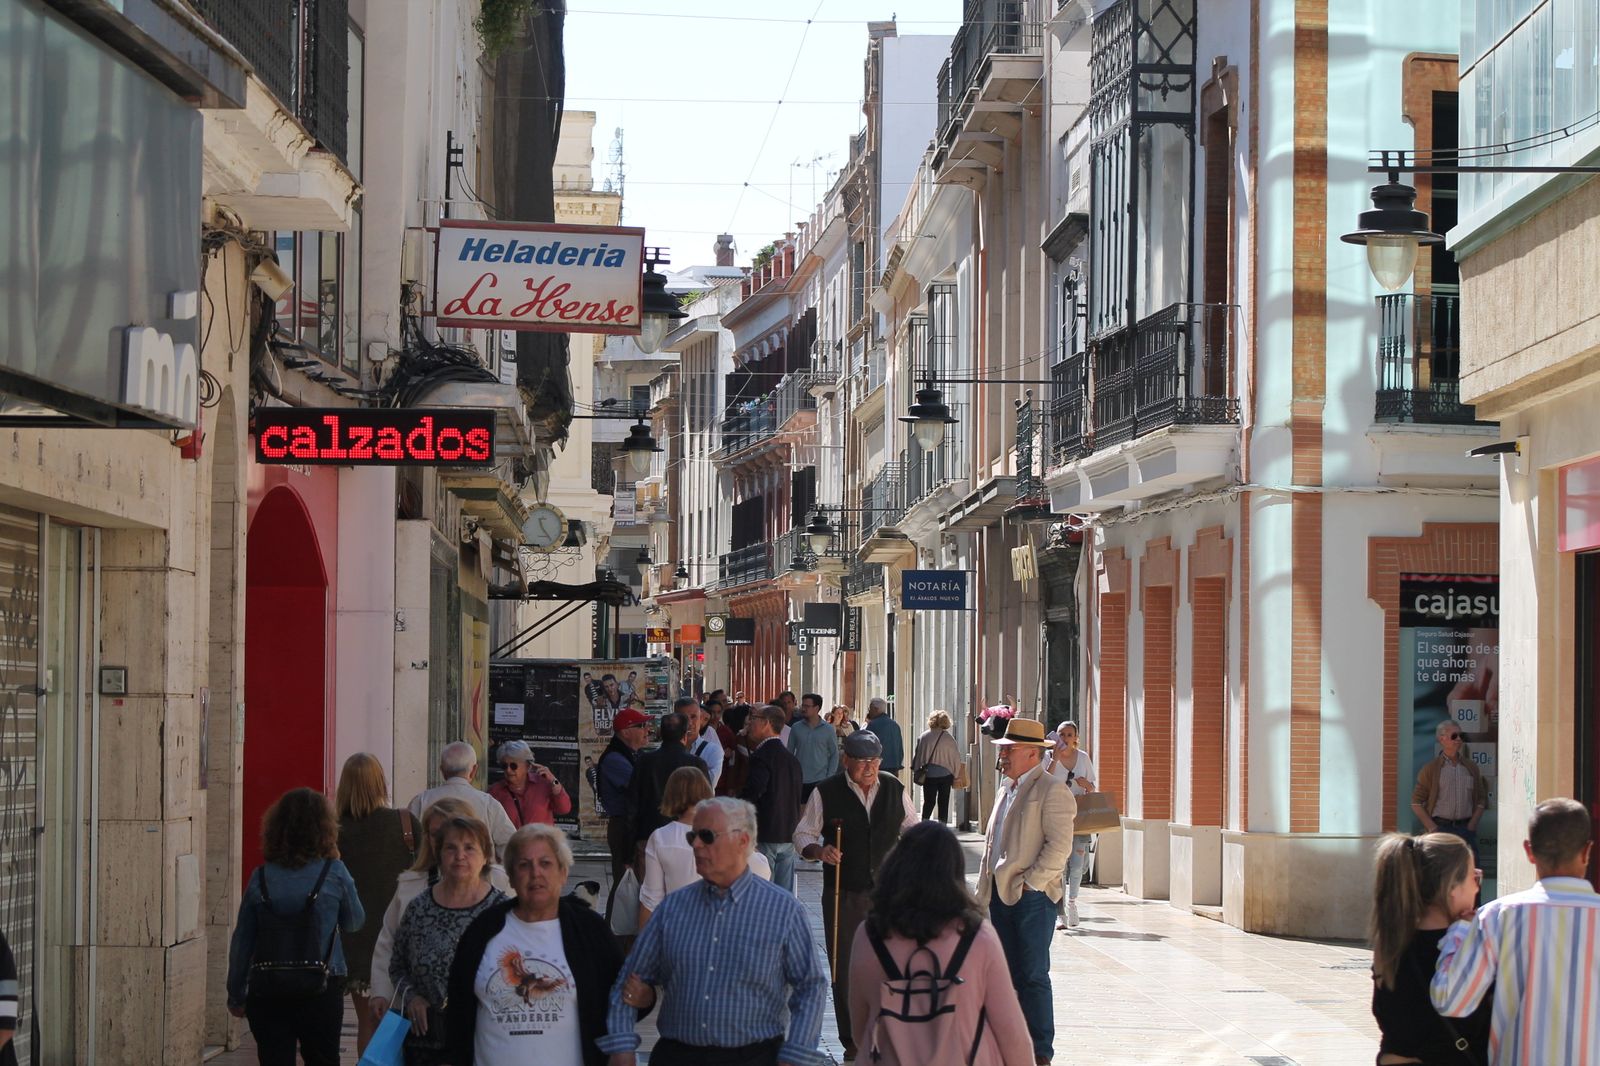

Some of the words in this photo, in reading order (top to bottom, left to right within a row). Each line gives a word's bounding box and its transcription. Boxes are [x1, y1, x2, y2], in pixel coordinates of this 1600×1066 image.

[458, 237, 626, 268] Heladeria
[443, 272, 502, 317] La
[260, 415, 489, 461] calzados
[908, 580, 961, 591] NOTARÍA
[1414, 587, 1499, 620] cajasu
[1417, 641, 1428, 653] El
[1431, 644, 1473, 656] seguro
[1476, 643, 1490, 654] de
[1417, 659, 1440, 670] que
[1442, 657, 1477, 668] ahora
[1417, 671, 1429, 682] te
[1432, 671, 1447, 682] da
[1449, 670, 1475, 682] más
[594, 720, 614, 729] DREA
[496, 1012, 559, 1024] WANDERER
